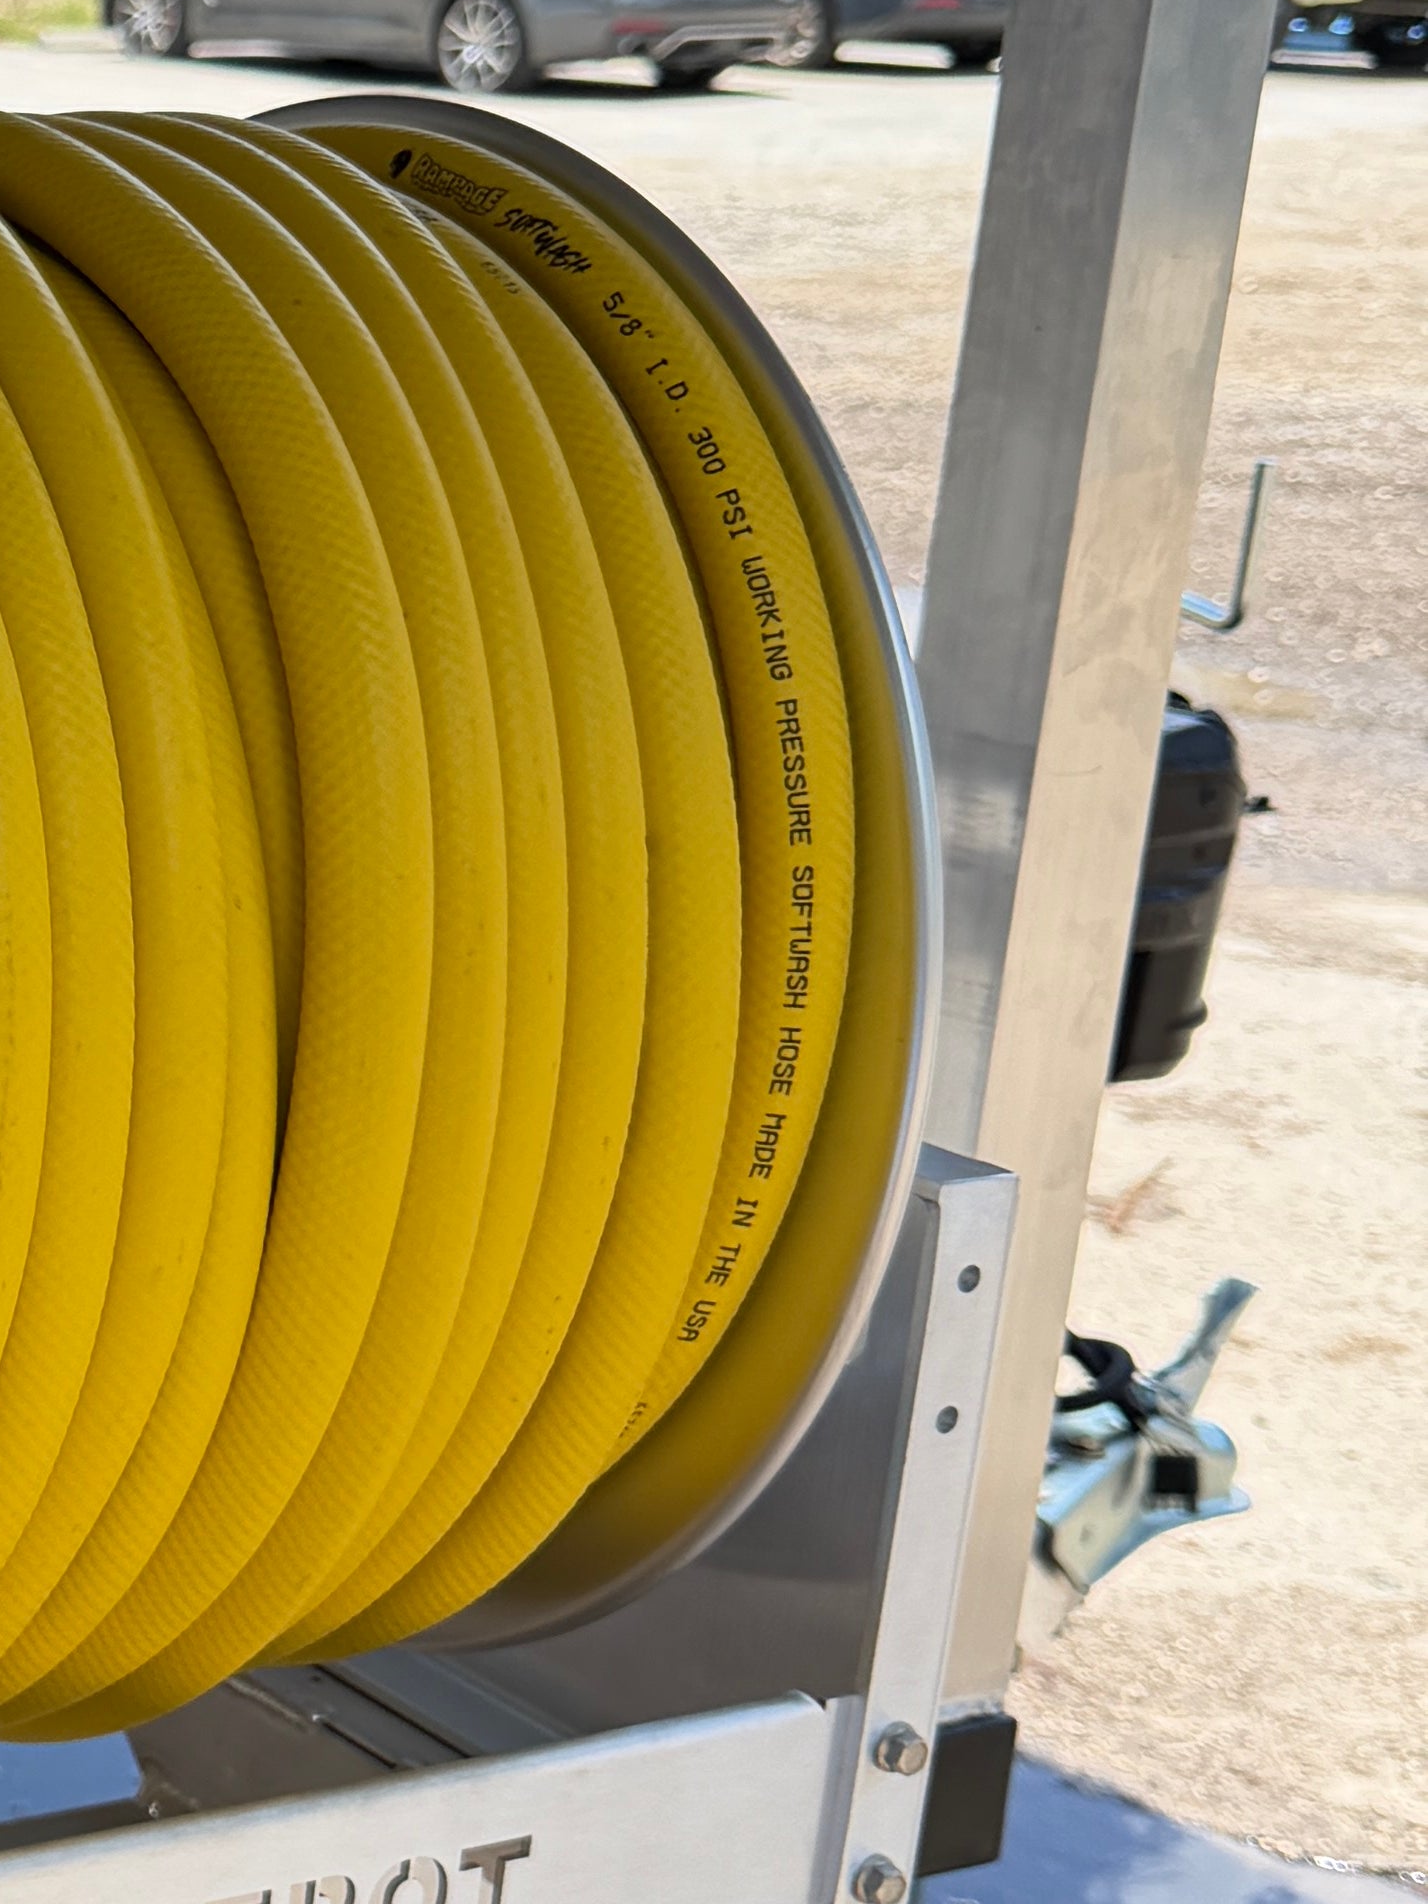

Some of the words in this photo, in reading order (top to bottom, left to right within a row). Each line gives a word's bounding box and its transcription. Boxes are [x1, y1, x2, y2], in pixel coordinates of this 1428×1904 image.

[411, 153, 509, 216] RAMPAGE
[602, 291, 655, 339] 5/8"
[645, 357, 689, 413] I.D.
[688, 425, 727, 475] 300
[715, 487, 753, 540] PSI
[741, 555, 794, 682] WORKING
[775, 698, 812, 845] PRESSURE
[784, 865, 816, 1008] SOFTWASH
[767, 1027, 801, 1096] HOSE
[748, 1112, 786, 1179] MADE
[731, 1195, 759, 1229] IN
[704, 1244, 742, 1286] THE
[677, 1299, 716, 1343] USA
